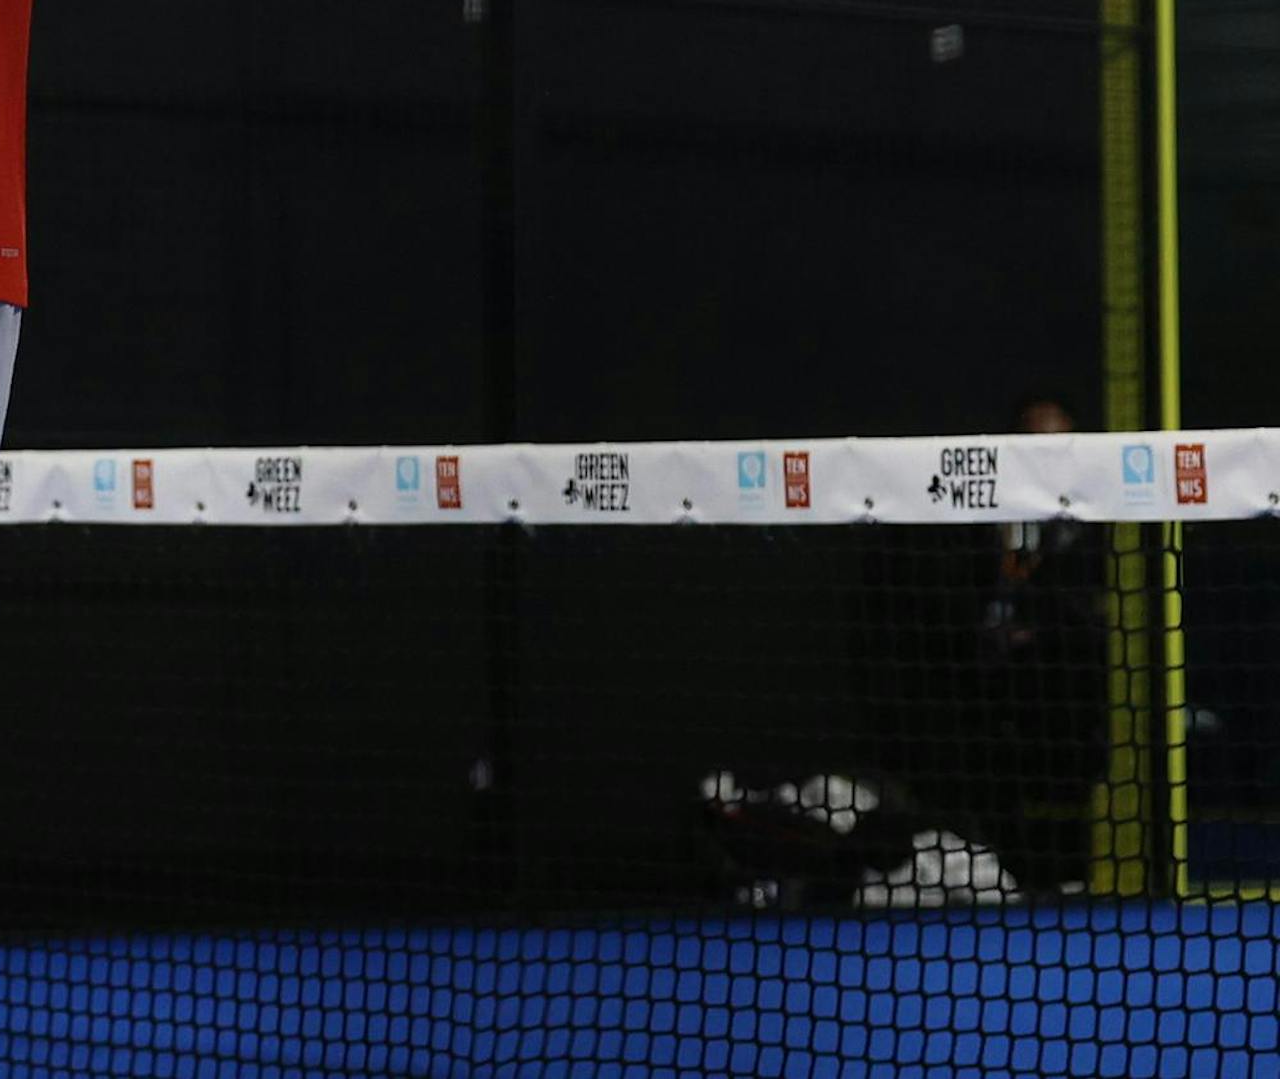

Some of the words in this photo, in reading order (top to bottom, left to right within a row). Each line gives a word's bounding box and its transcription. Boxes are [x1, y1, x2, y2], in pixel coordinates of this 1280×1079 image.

[256, 457, 302, 482] GREEN
[576, 453, 629, 480] GREEN
[941, 447, 997, 476] GREEN
[1177, 451, 1203, 469] TEN
[262, 486, 301, 511] WEEZ
[581, 484, 629, 510] WEEZ
[950, 479, 998, 507] WEEZ
[1179, 478, 1204, 498] NIS
